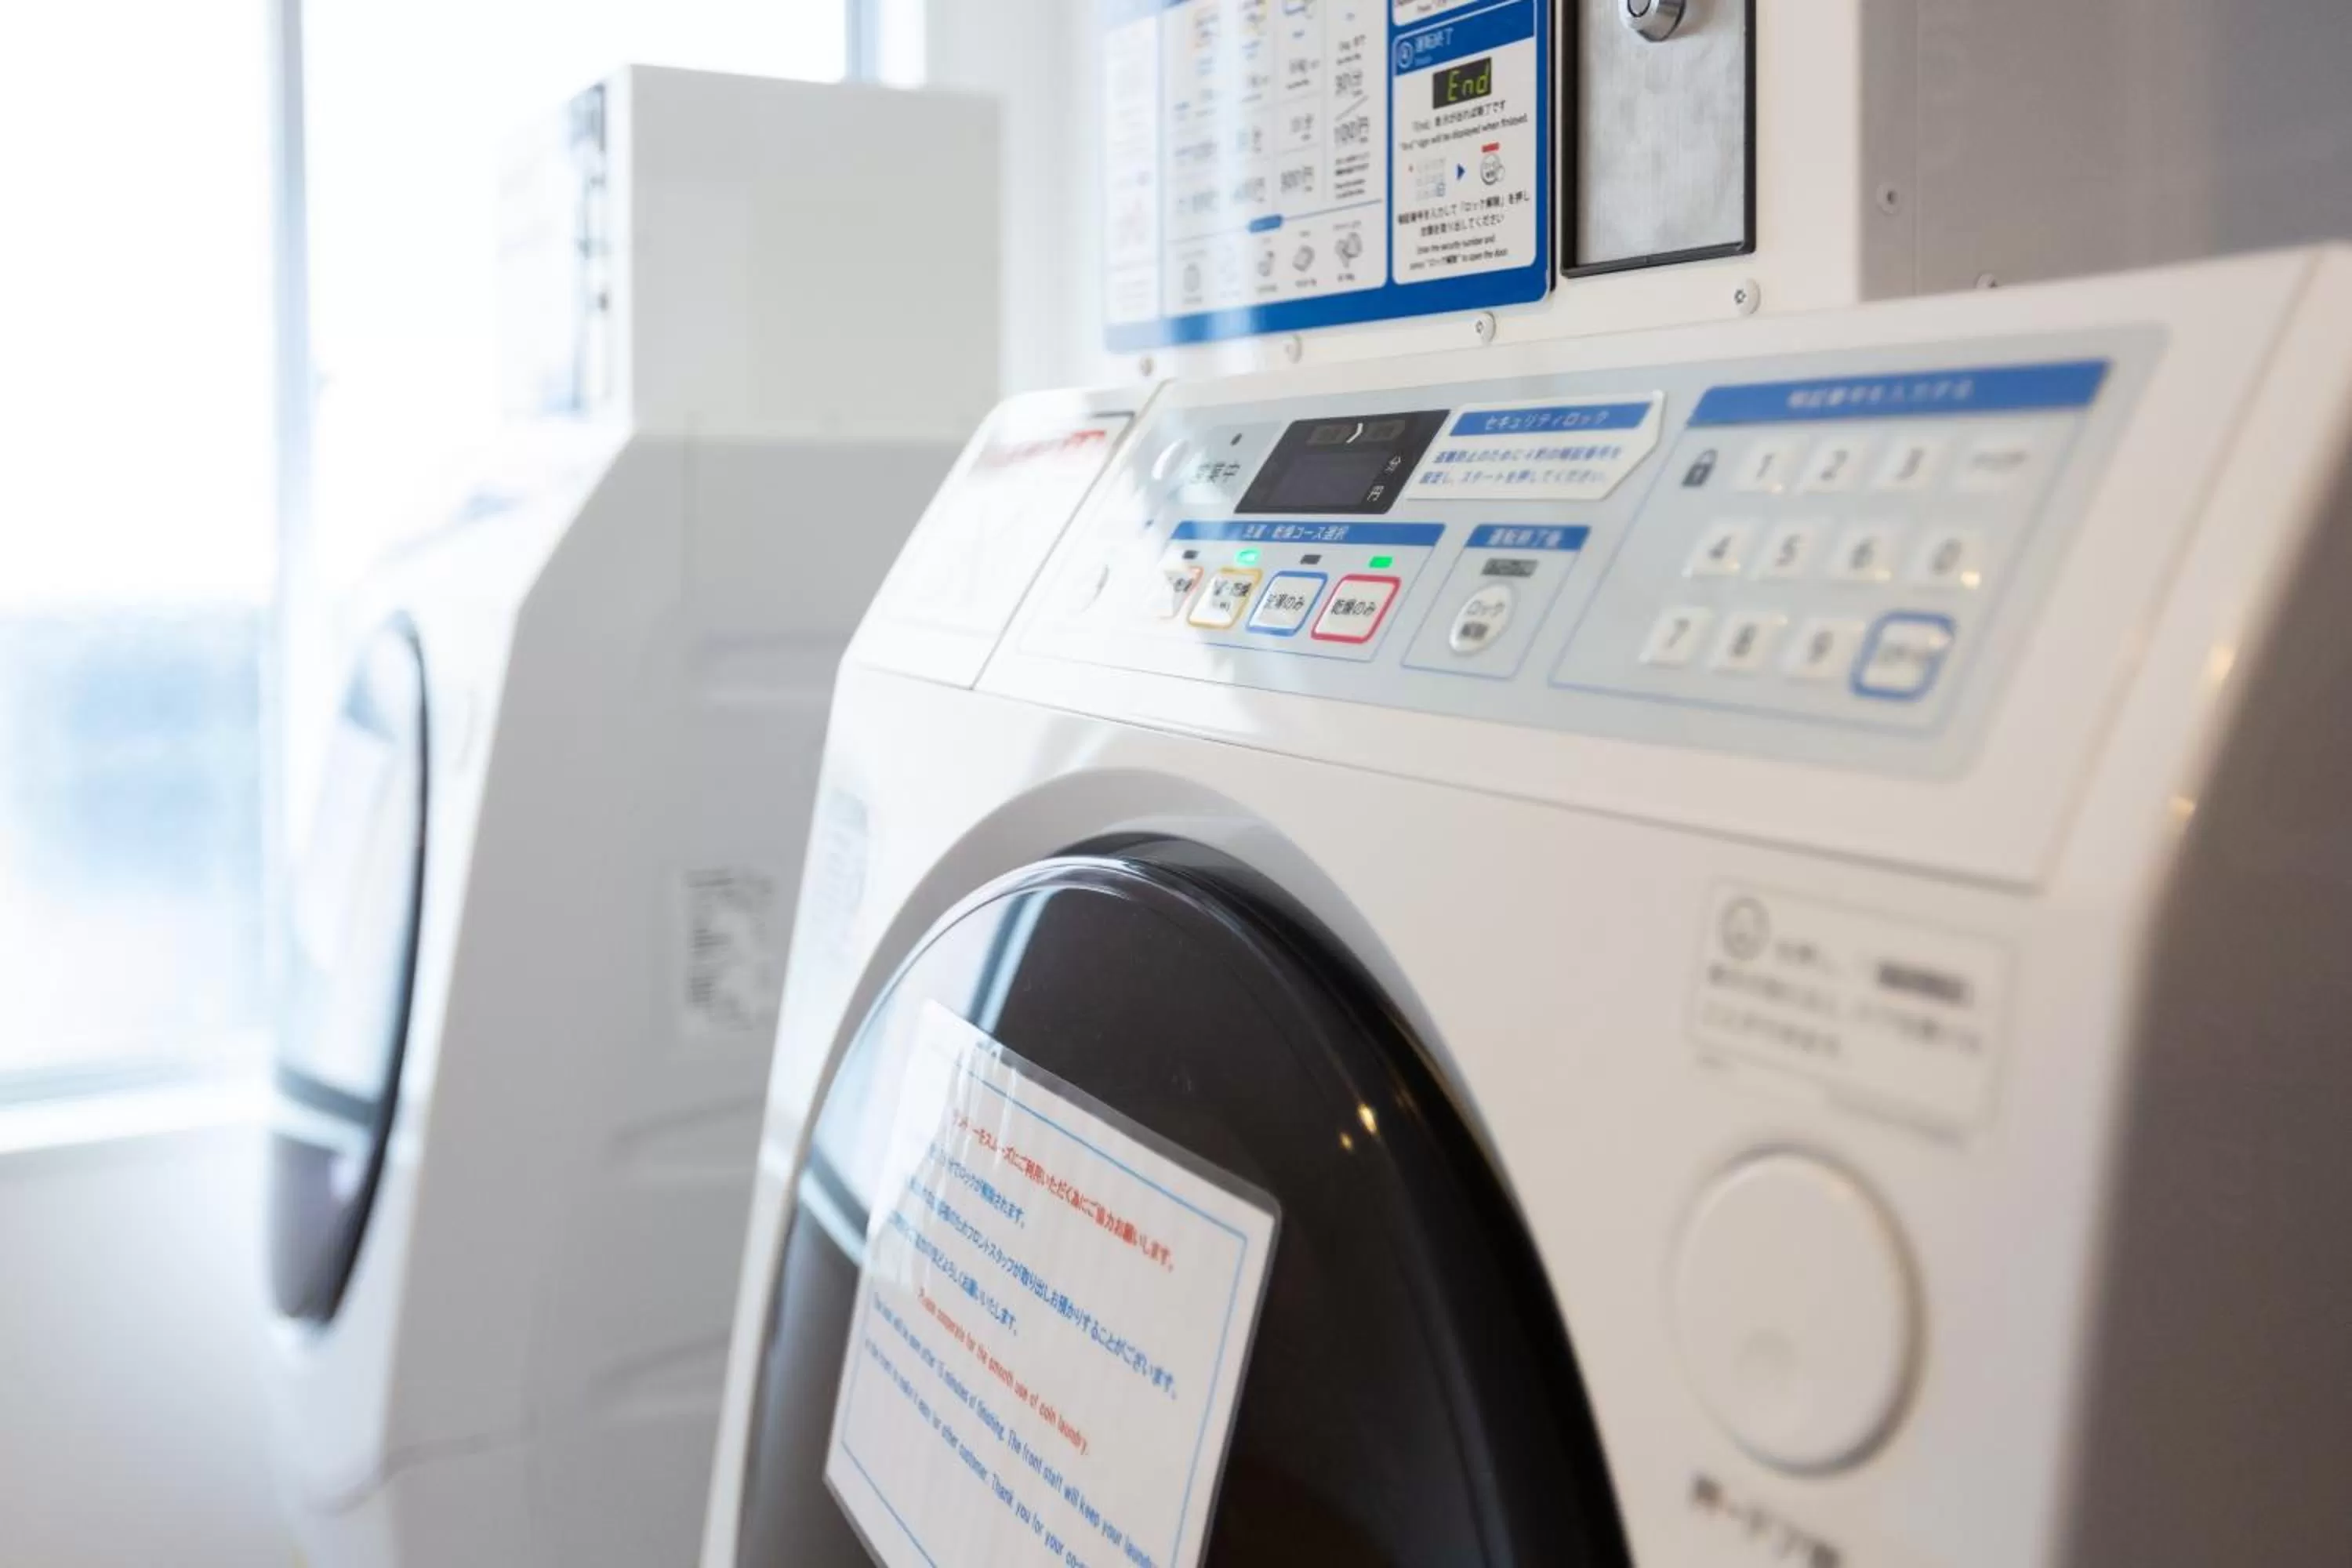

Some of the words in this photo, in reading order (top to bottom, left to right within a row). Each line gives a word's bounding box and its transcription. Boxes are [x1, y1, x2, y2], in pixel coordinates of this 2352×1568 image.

[1447, 60, 1490, 102] End
[1485, 412, 1610, 430] セキュリティロック
[1708, 535, 1731, 562] 4
[1776, 535, 1803, 567] 5
[1849, 536, 1877, 570] 6
[1932, 539, 1962, 575] 0
[1667, 617, 1690, 649] 7
[1731, 623, 1758, 657] 8
[1806, 629, 1834, 663] 9
[1007, 1429, 1022, 1453] The
[1022, 1443, 1043, 1473] front
[1042, 1462, 1062, 1491] staff
[1063, 1481, 1080, 1507] will
[1078, 1497, 1100, 1526] keep
[1100, 1519, 1123, 1550] your
[991, 1474, 1013, 1507] Thank
[1015, 1502, 1030, 1526] you
[1031, 1514, 1044, 1537] for
[1044, 1529, 1065, 1559] your
